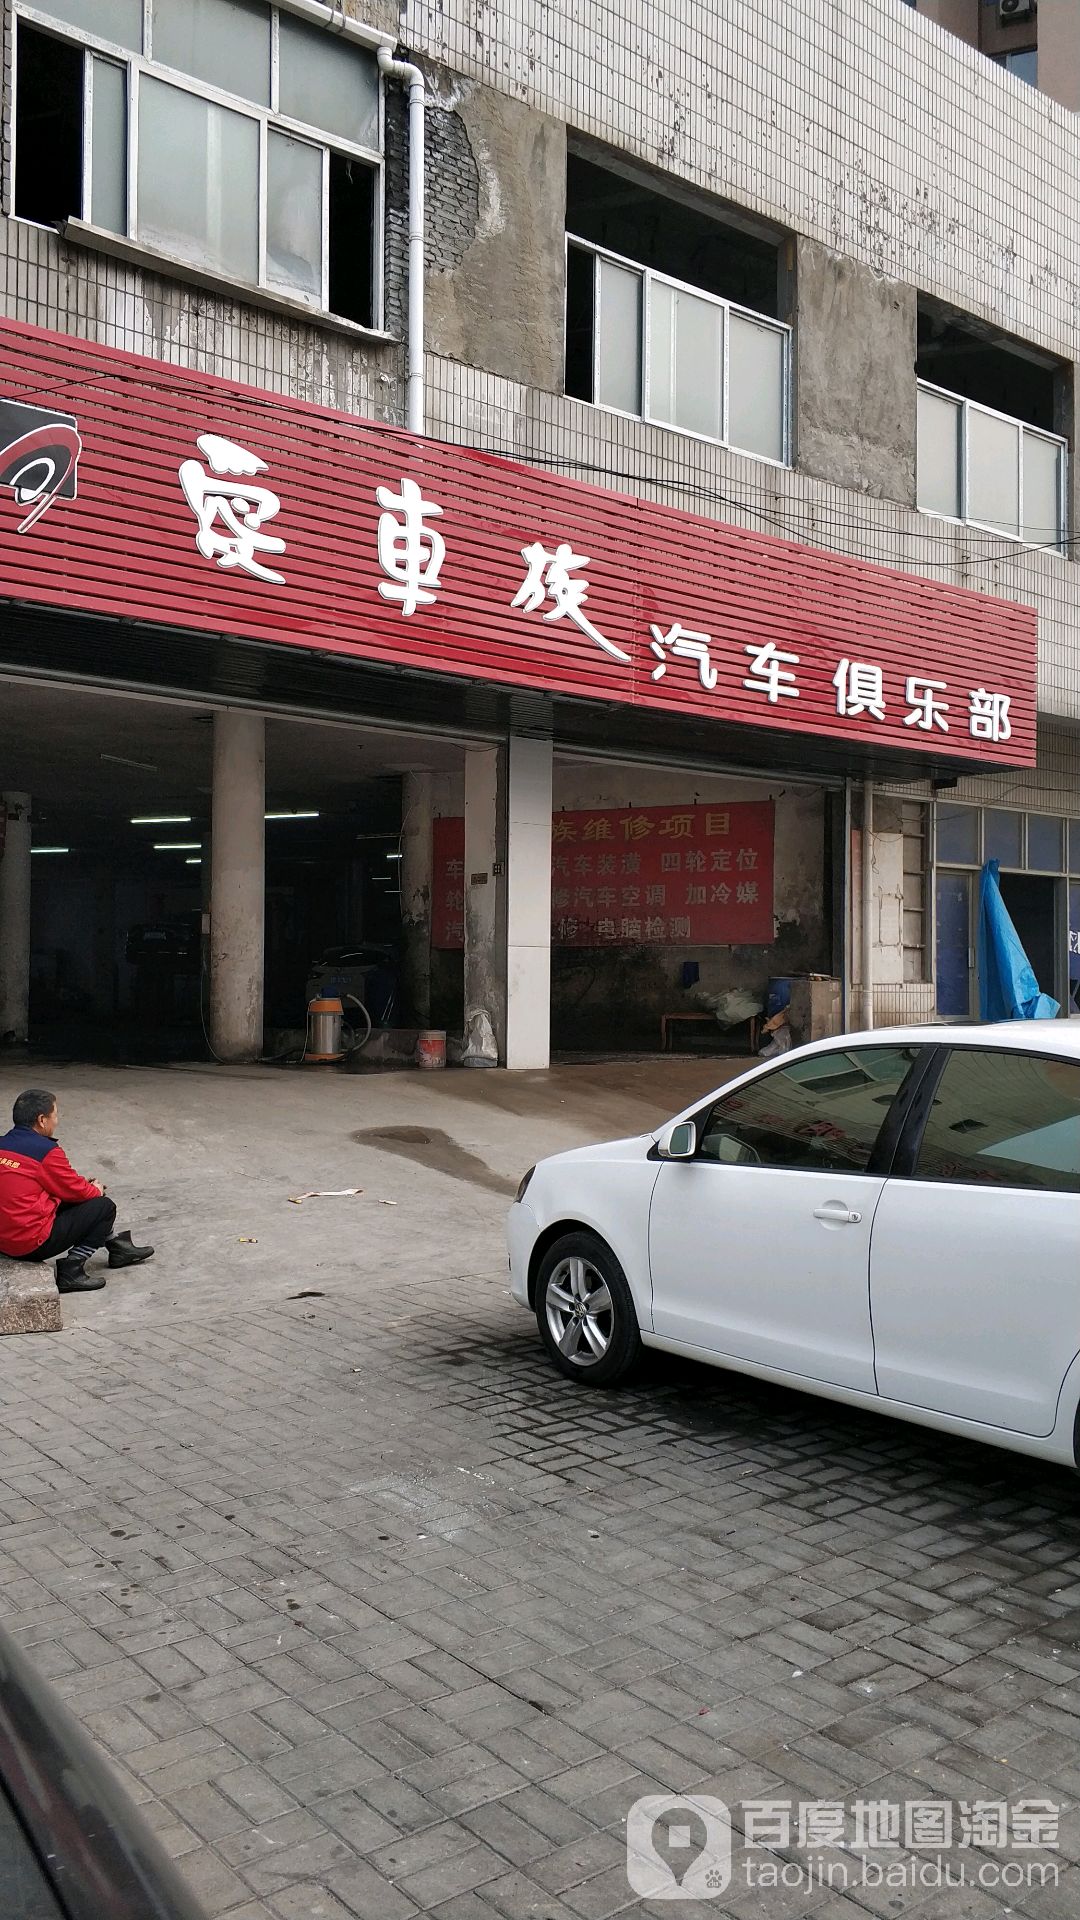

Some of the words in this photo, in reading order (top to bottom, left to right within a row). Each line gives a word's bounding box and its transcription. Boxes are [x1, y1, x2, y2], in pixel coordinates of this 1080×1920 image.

[650, 622, 1012, 742] 汽车俱乐部
[660, 847, 759, 873] 四轮定位
[684, 880, 759, 906] 加冷媒
